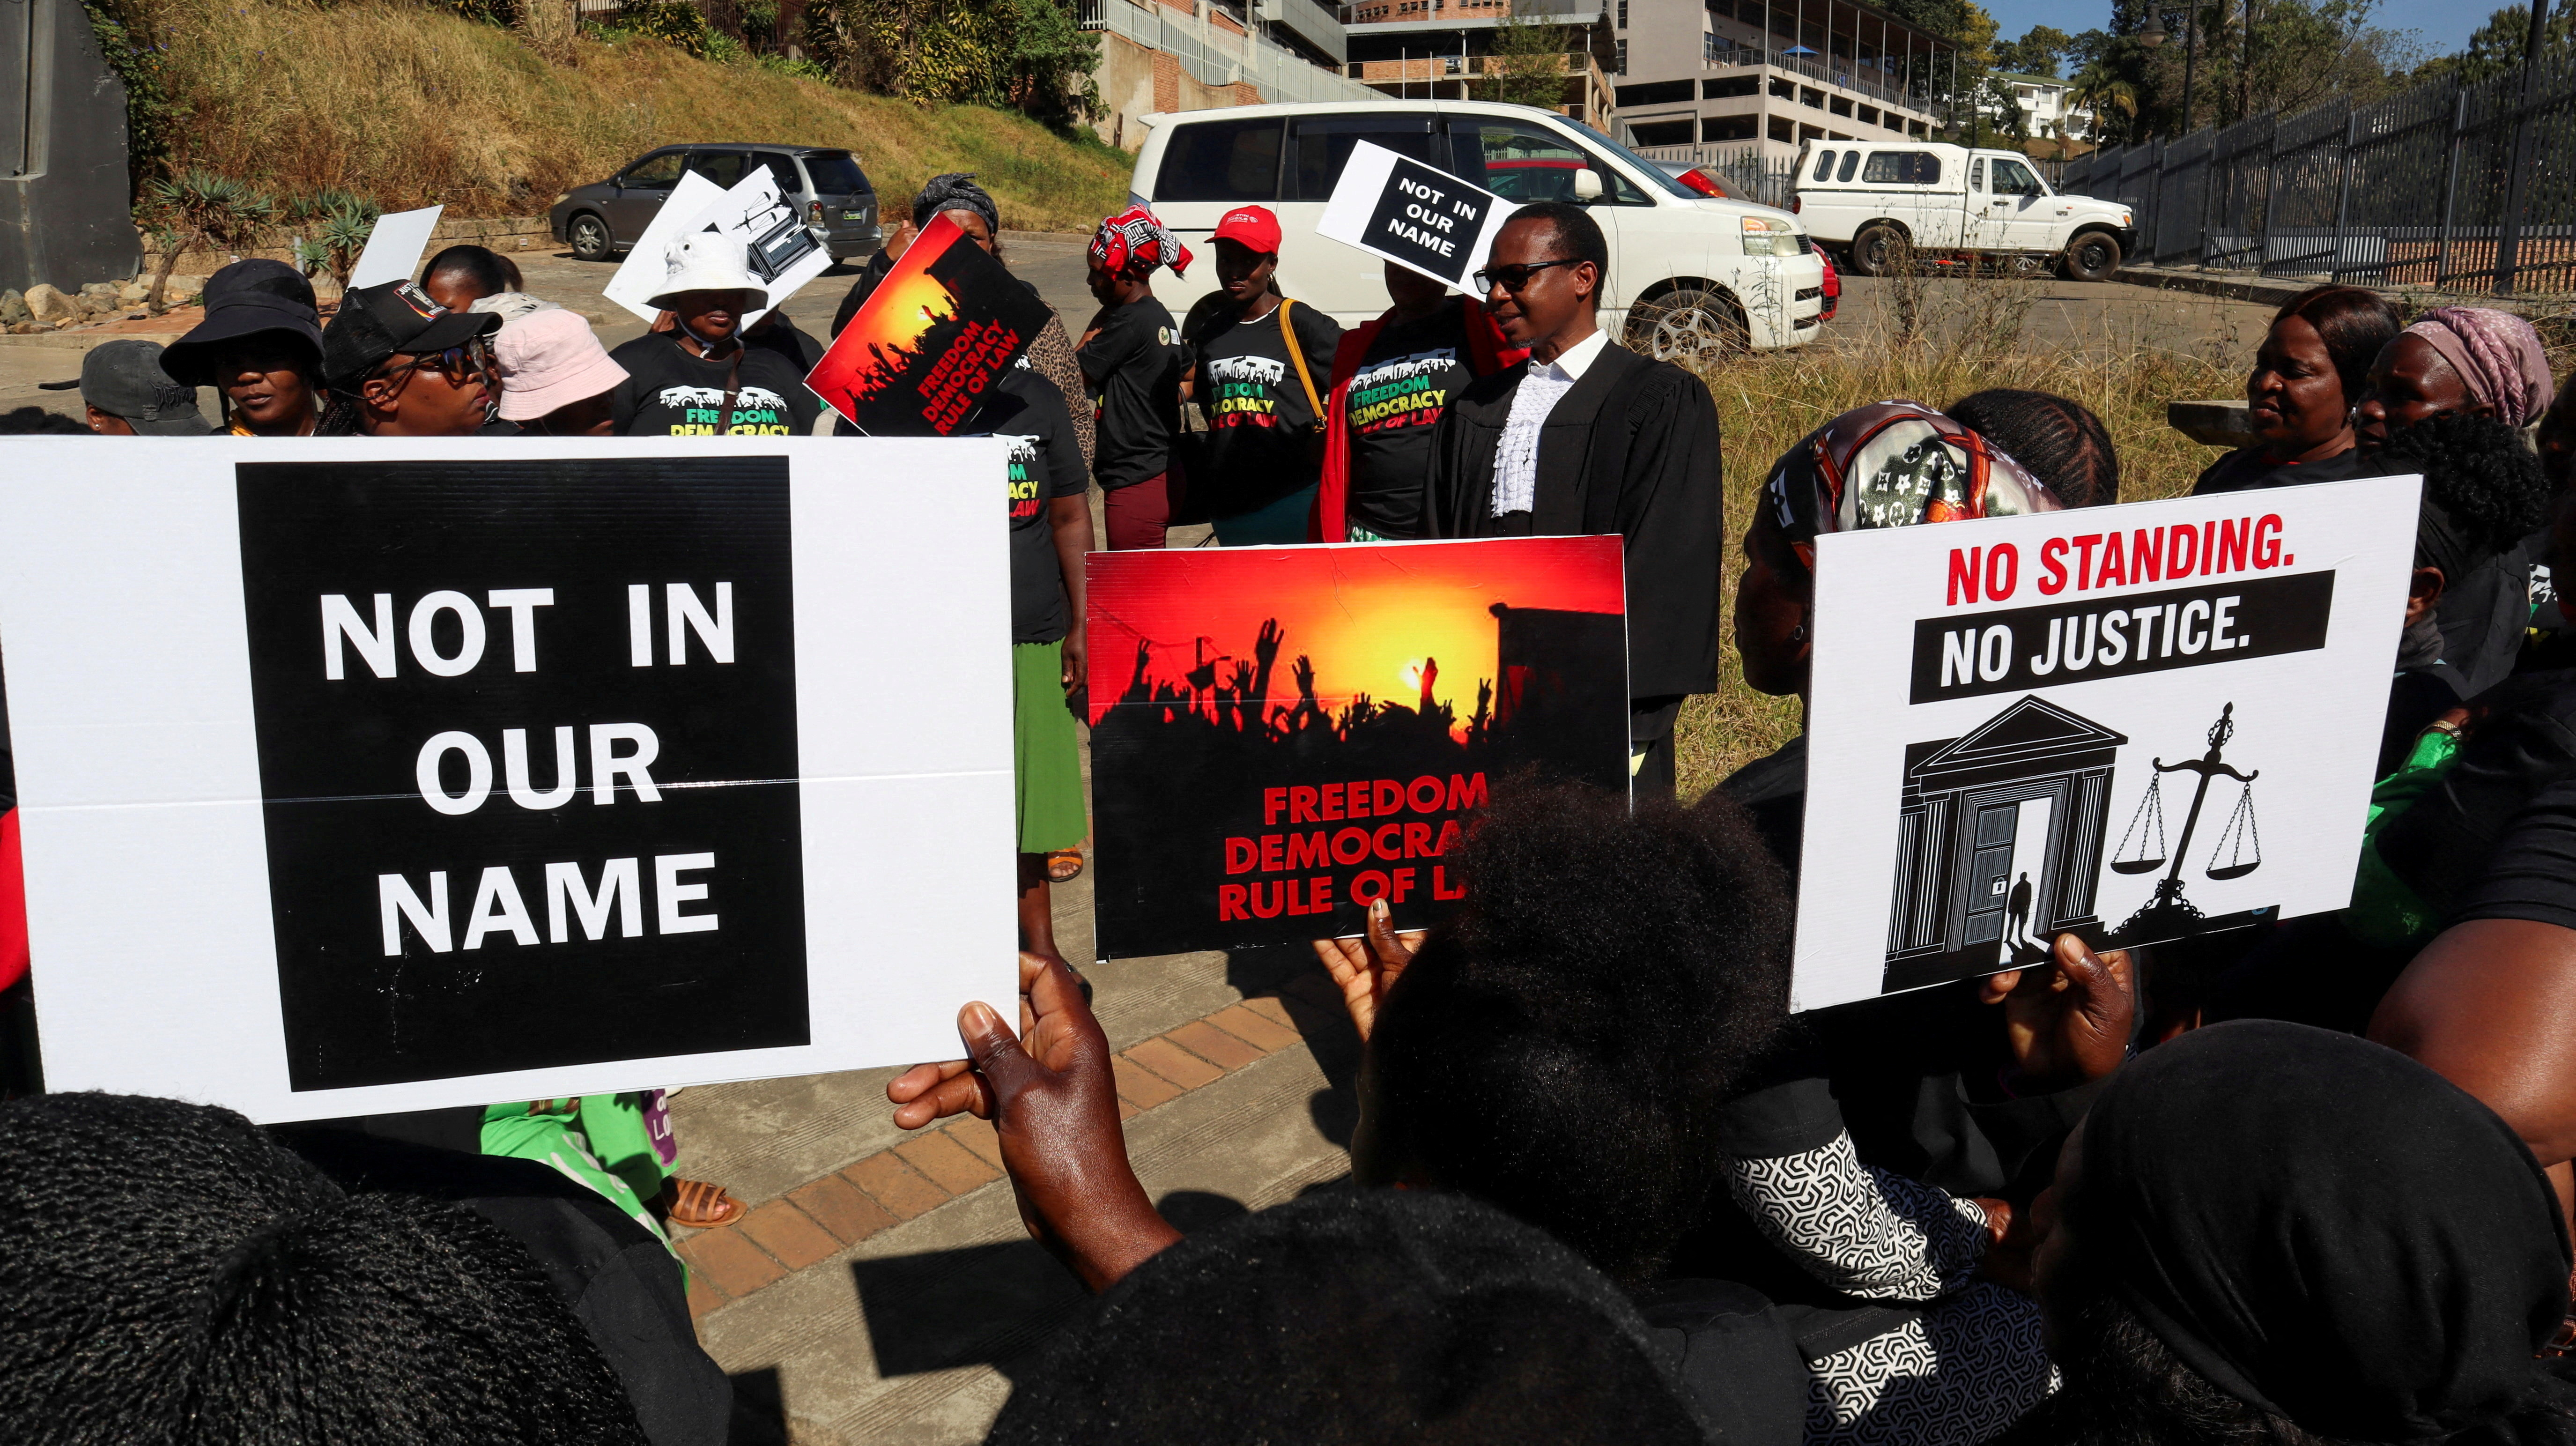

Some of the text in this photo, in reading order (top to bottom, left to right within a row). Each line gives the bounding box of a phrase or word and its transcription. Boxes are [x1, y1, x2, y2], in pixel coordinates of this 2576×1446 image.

[1398, 177, 1477, 221] NOT IN
[1406, 204, 1454, 234] OUR
[1387, 218, 1456, 258] NAME
[918, 320, 983, 398] FREEDOM
[922, 319, 1004, 422] DEMOCRACY
[934, 329, 1019, 436] RULE OF LAW
[686, 408, 778, 424] FREDOM
[1347, 389, 1446, 428] DEMOCRACY
[1354, 375, 1430, 408] FREEDOM
[670, 424, 790, 436] DEMCRACY
[1385, 414, 1408, 428] OF
[1947, 513, 2294, 606] NO STANDING.
[321, 582, 734, 680] NOT IN
[1940, 595, 2250, 687] NO JUSTICE.
[416, 722, 662, 815] OUR
[1264, 772, 1488, 825] FREEDOM
[1225, 820, 1466, 875] DEMOCRA
[378, 852, 719, 956] NAME
[1219, 875, 1333, 921] RULE
[1350, 868, 1415, 908] OF
